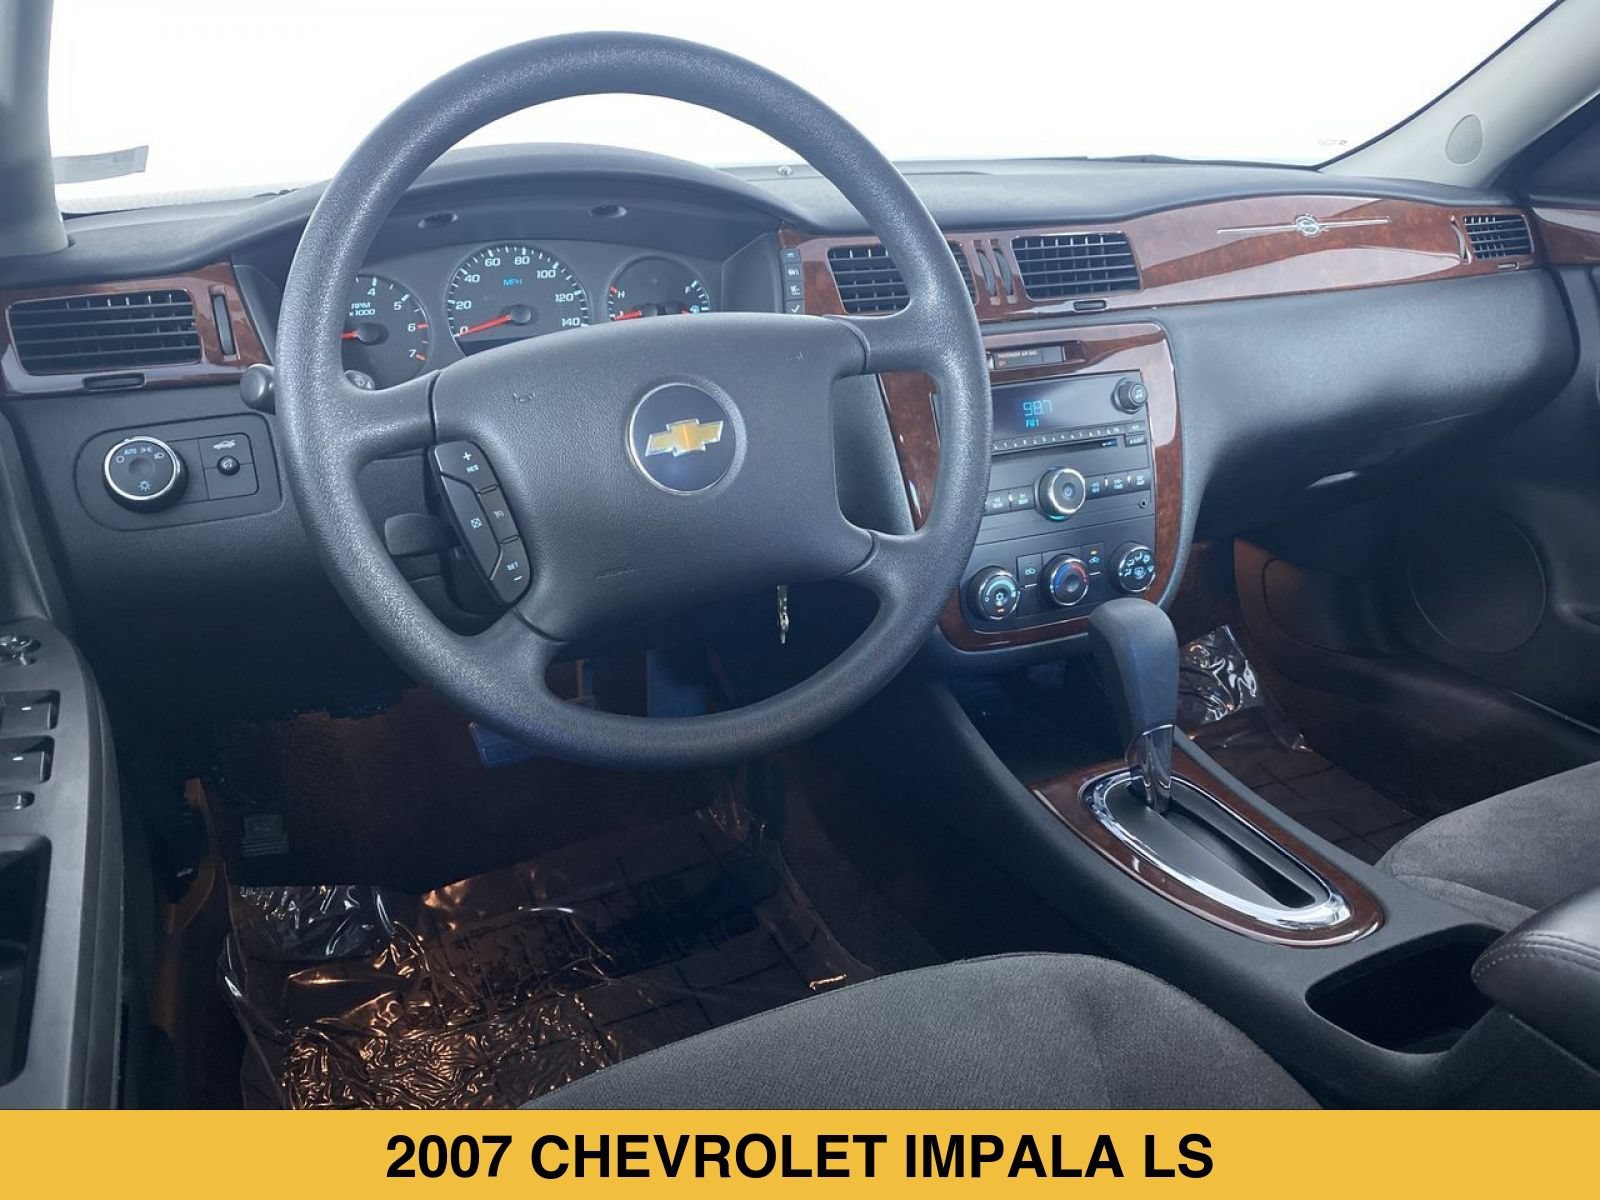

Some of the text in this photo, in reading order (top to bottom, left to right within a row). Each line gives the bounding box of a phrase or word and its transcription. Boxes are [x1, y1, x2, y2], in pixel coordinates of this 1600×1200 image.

[484, 257, 501, 267] 60
[514, 255, 530, 265] 80
[464, 274, 480, 284] 40
[536, 269, 556, 279] 100
[367, 287, 376, 297] 4
[617, 290, 626, 299] H
[555, 293, 574, 303] 120
[351, 302, 371, 310] RPM
[393, 301, 403, 311] 5
[455, 300, 472, 310] 20
[561, 317, 580, 327] 140
[407, 323, 416, 332] 6
[459, 325, 469, 335] 0
[408, 348, 417, 358] 7
